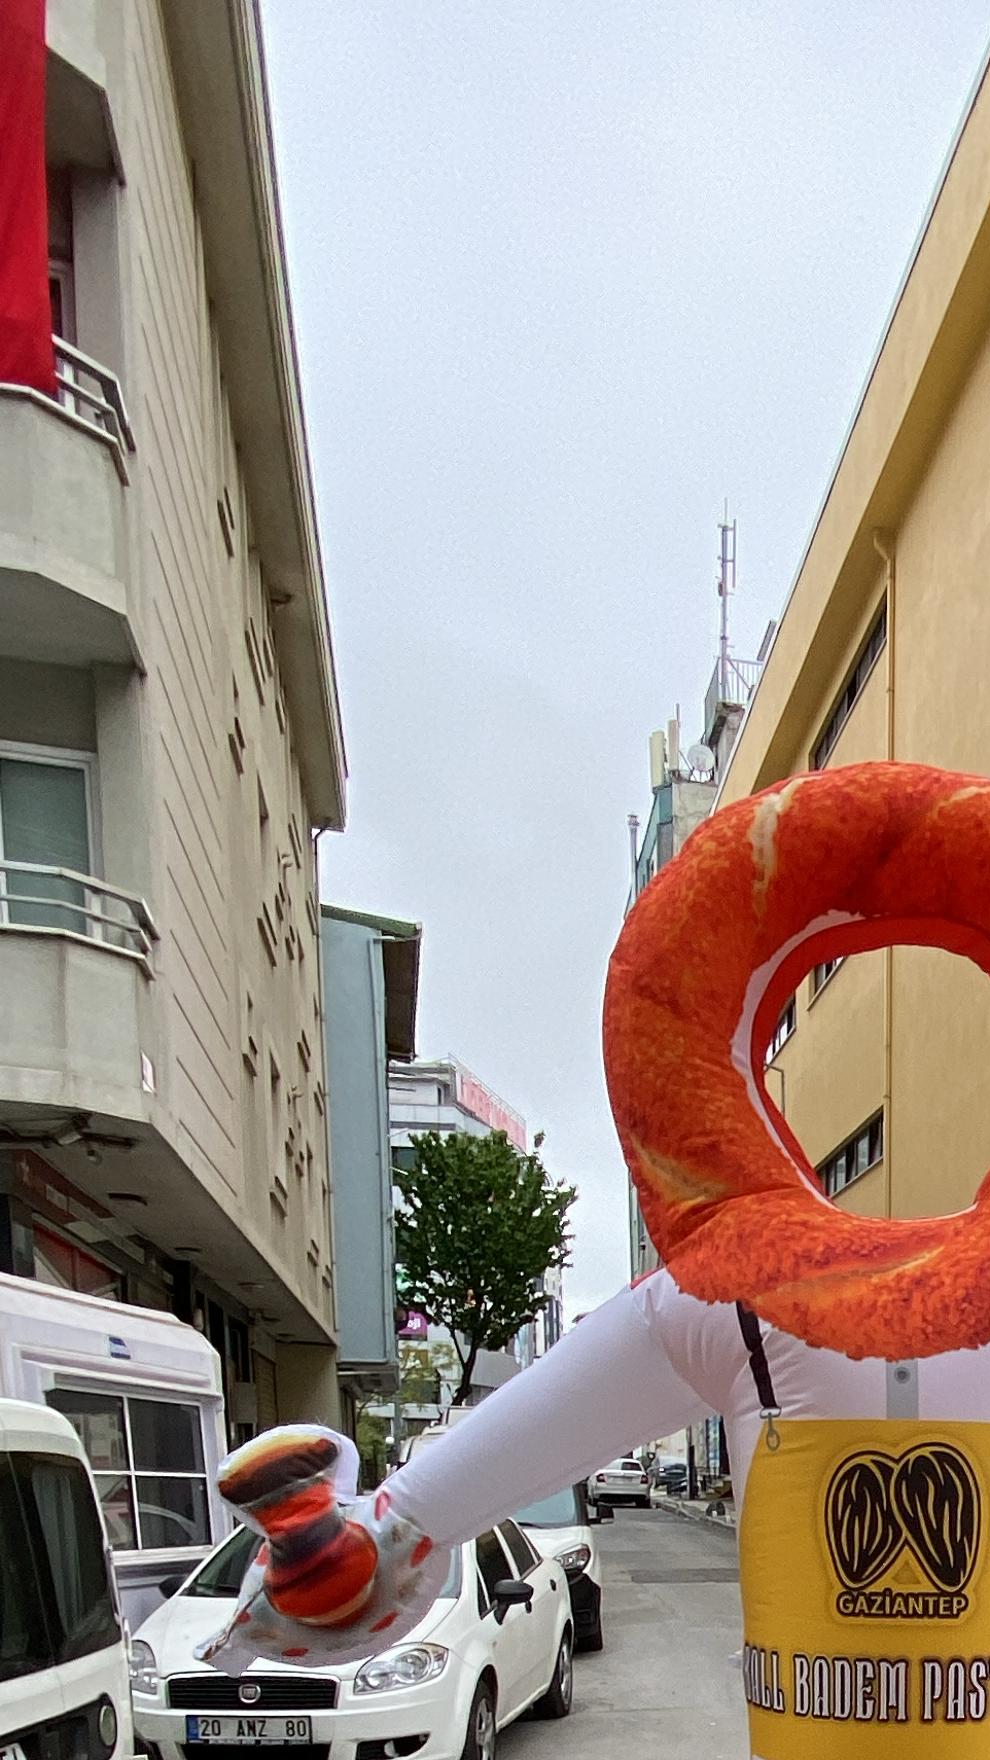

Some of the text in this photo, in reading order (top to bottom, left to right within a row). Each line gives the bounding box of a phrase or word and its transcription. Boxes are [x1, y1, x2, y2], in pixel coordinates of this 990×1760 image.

[838, 1588, 967, 1616] GAZİANTEP
[793, 1653, 908, 1720] BADEM
[200, 1719, 307, 1737] 20 ANZ 80
